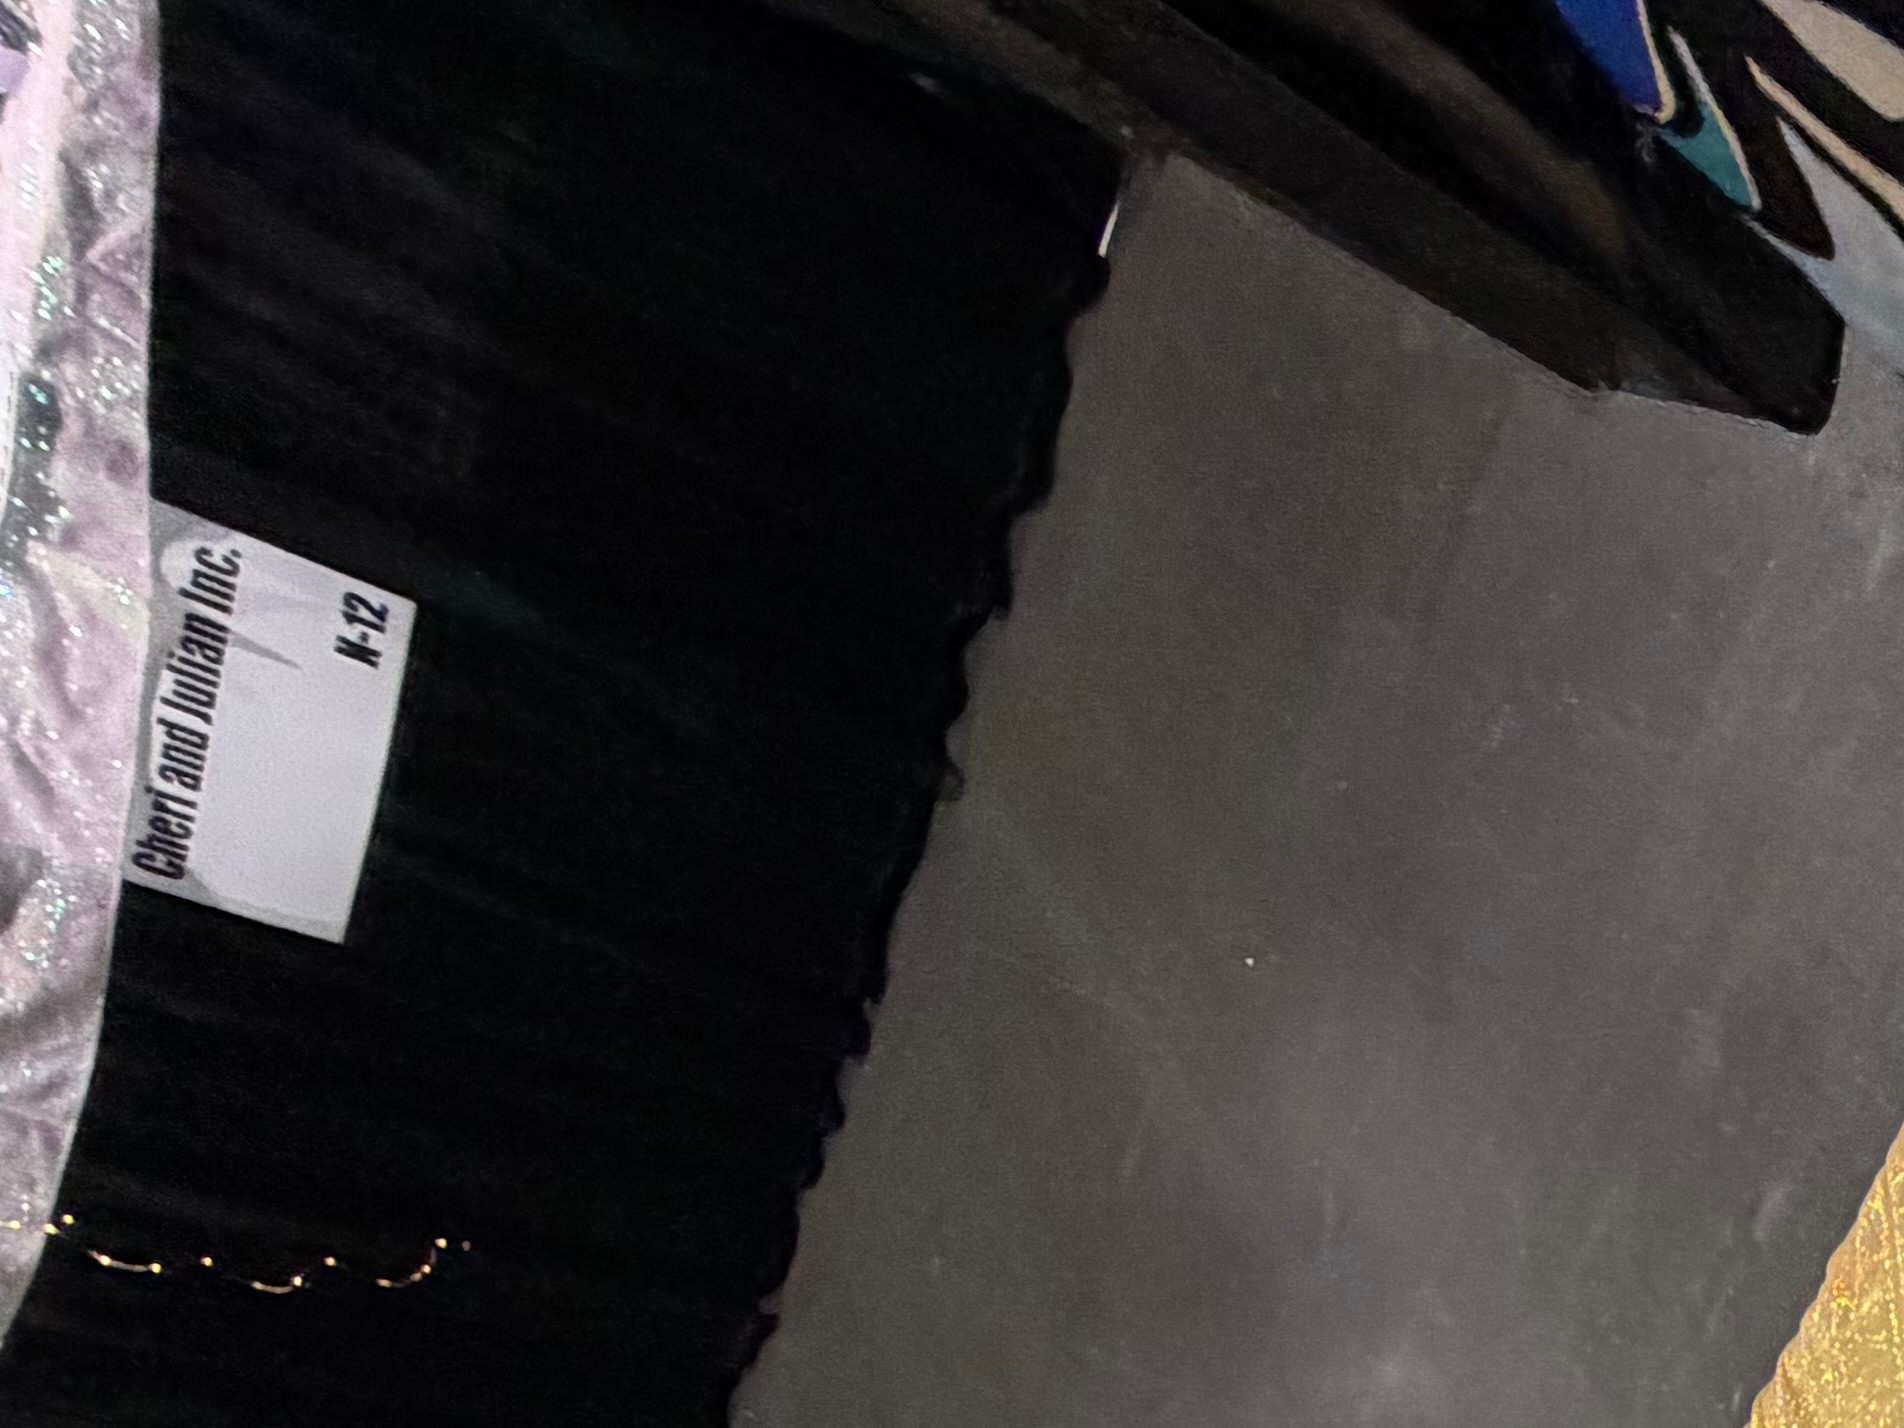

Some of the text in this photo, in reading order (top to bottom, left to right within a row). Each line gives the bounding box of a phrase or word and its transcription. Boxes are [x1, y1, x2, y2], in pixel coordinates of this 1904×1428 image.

[131, 545, 244, 882] Cheri and Julian Inc.
